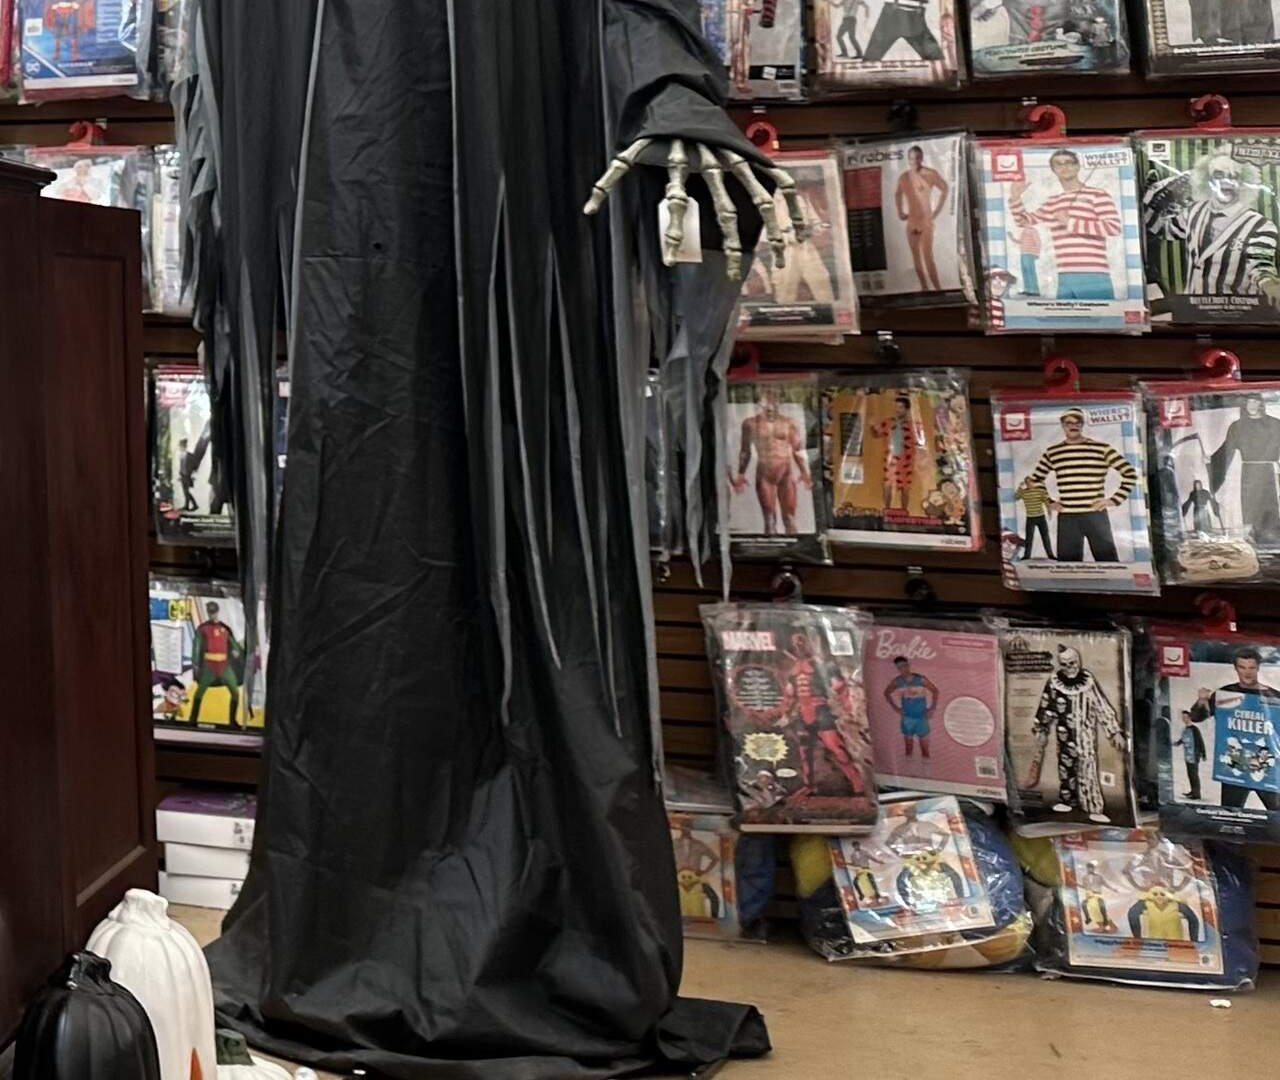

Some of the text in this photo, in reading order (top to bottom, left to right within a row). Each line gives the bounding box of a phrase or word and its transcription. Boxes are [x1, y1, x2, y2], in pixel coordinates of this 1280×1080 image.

[721, 631, 776, 651] MARVEL
[876, 629, 936, 660] Barbie
[1234, 709, 1265, 721] CEREAL
[1227, 717, 1274, 735] KILLER
